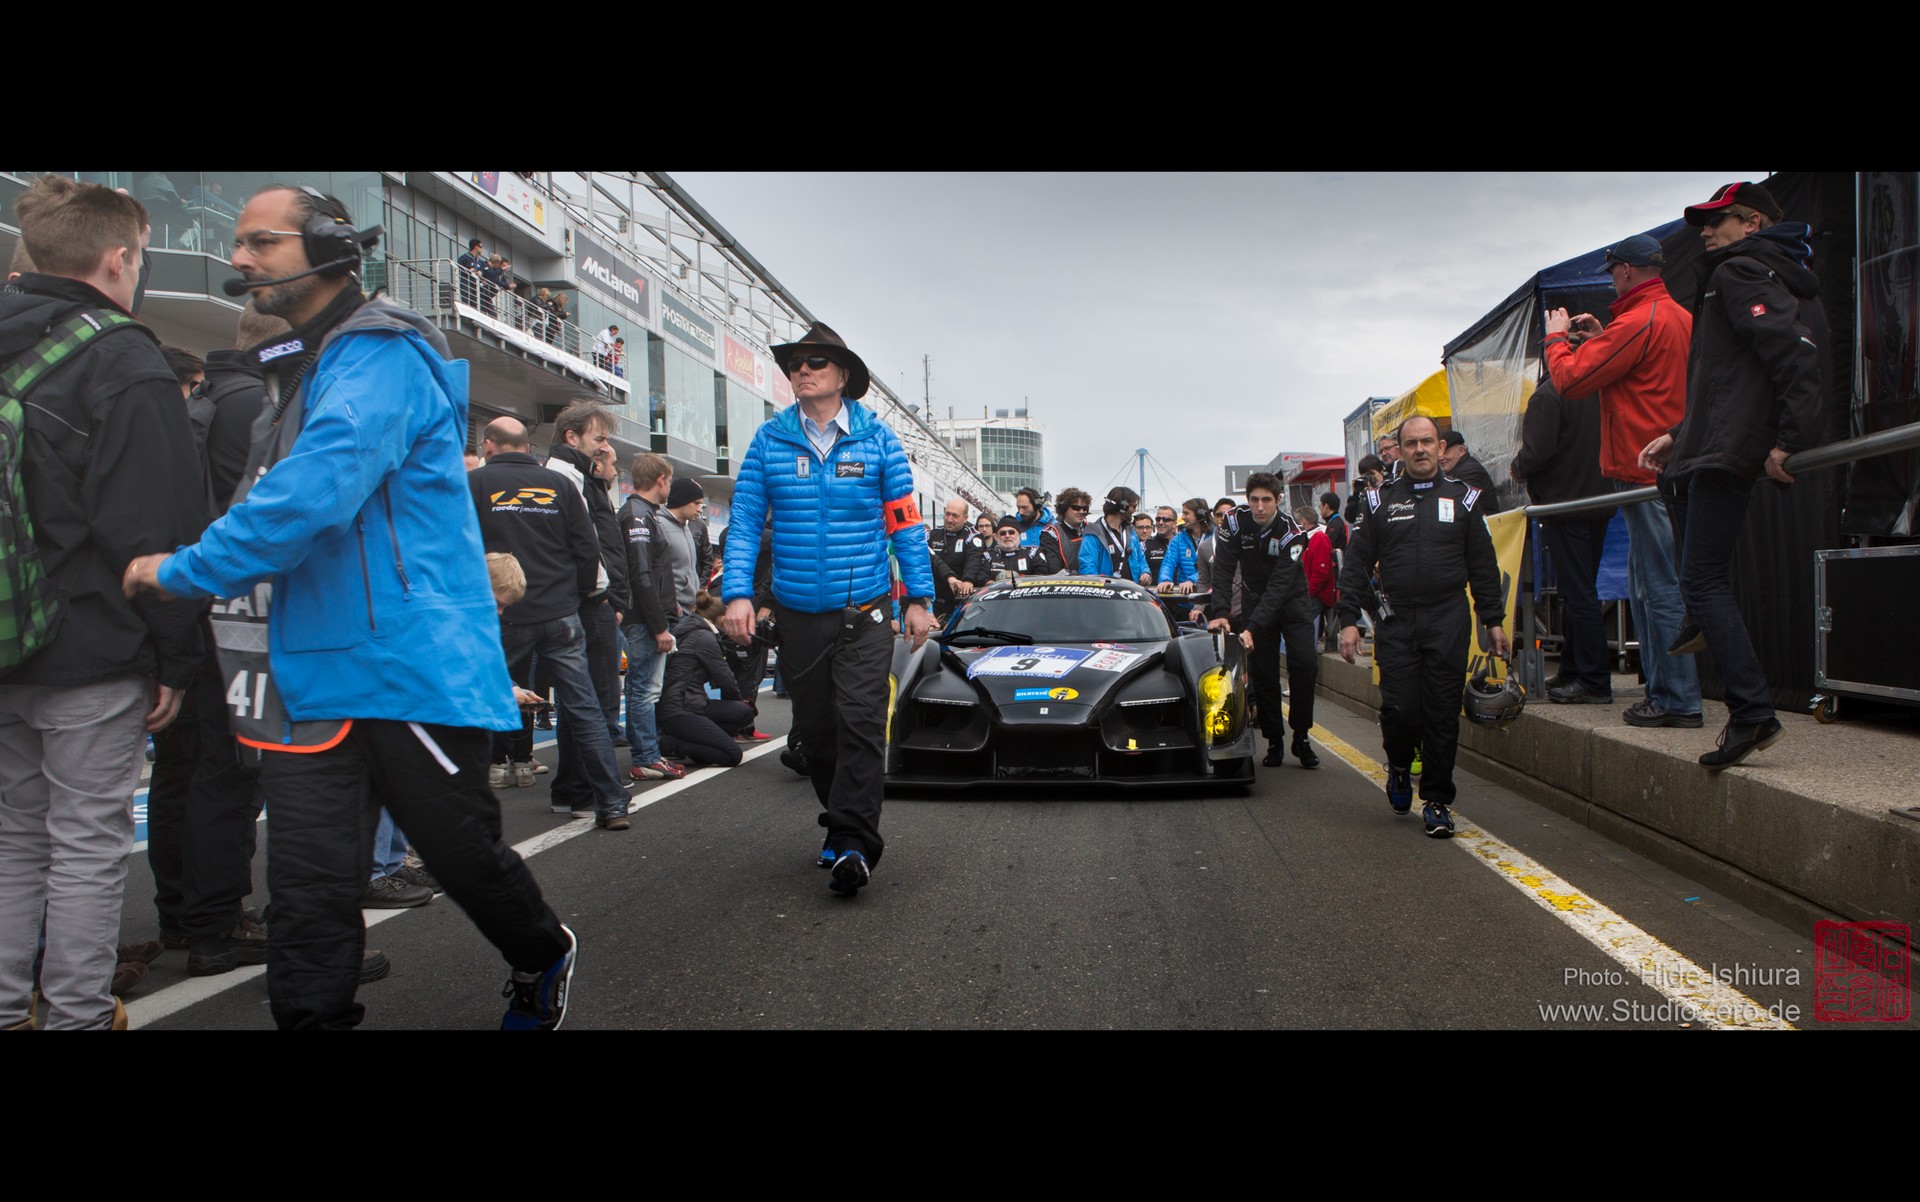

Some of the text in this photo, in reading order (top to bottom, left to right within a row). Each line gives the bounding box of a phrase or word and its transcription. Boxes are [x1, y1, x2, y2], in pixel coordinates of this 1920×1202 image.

[582, 256, 639, 304] McLaren
[1010, 585, 1051, 596] GRAN
[1054, 585, 1115, 596] TURISMO
[1010, 658, 1041, 671] 9
[226, 669, 268, 720] 41
